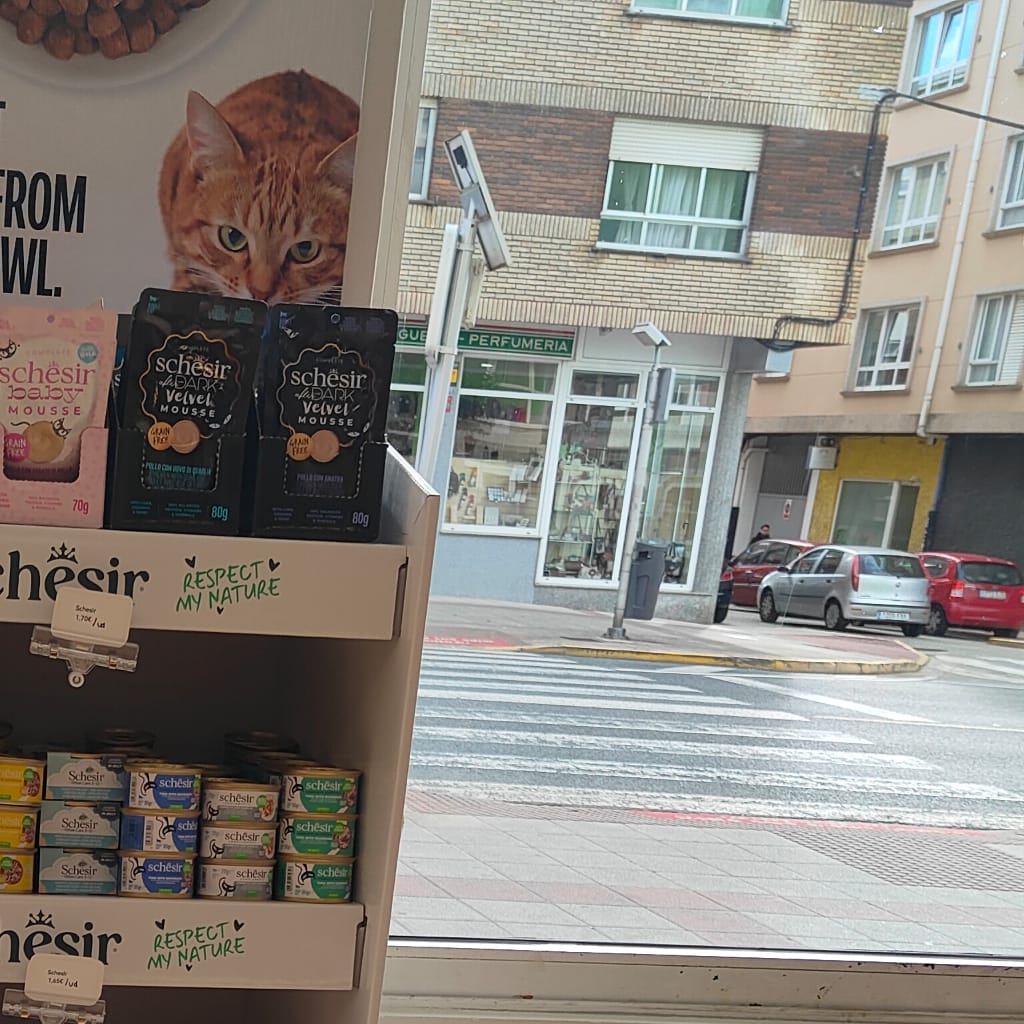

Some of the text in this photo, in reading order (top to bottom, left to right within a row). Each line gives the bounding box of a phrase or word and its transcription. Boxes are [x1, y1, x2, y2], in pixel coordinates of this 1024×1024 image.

[468, 333, 568, 353] PERFUMERIA
[7, 385, 84, 404] baby
[8, 405, 81, 416] MOUSSE
[160, 404, 216, 418] MOUSSE
[298, 416, 354, 426] MOUSSE
[73, 498, 89, 514] 70g
[211, 506, 228, 521] 80g
[352, 511, 369, 527] 80g
[183, 561, 266, 591] RESPECT
[175, 578, 281, 614] MY NATURE
[68, 771, 105, 782] Schesir
[61, 818, 98, 830] Schesir
[61, 865, 98, 876] Schesir
[153, 922, 230, 951] RESPECT
[147, 937, 245, 971] MY NATURE
